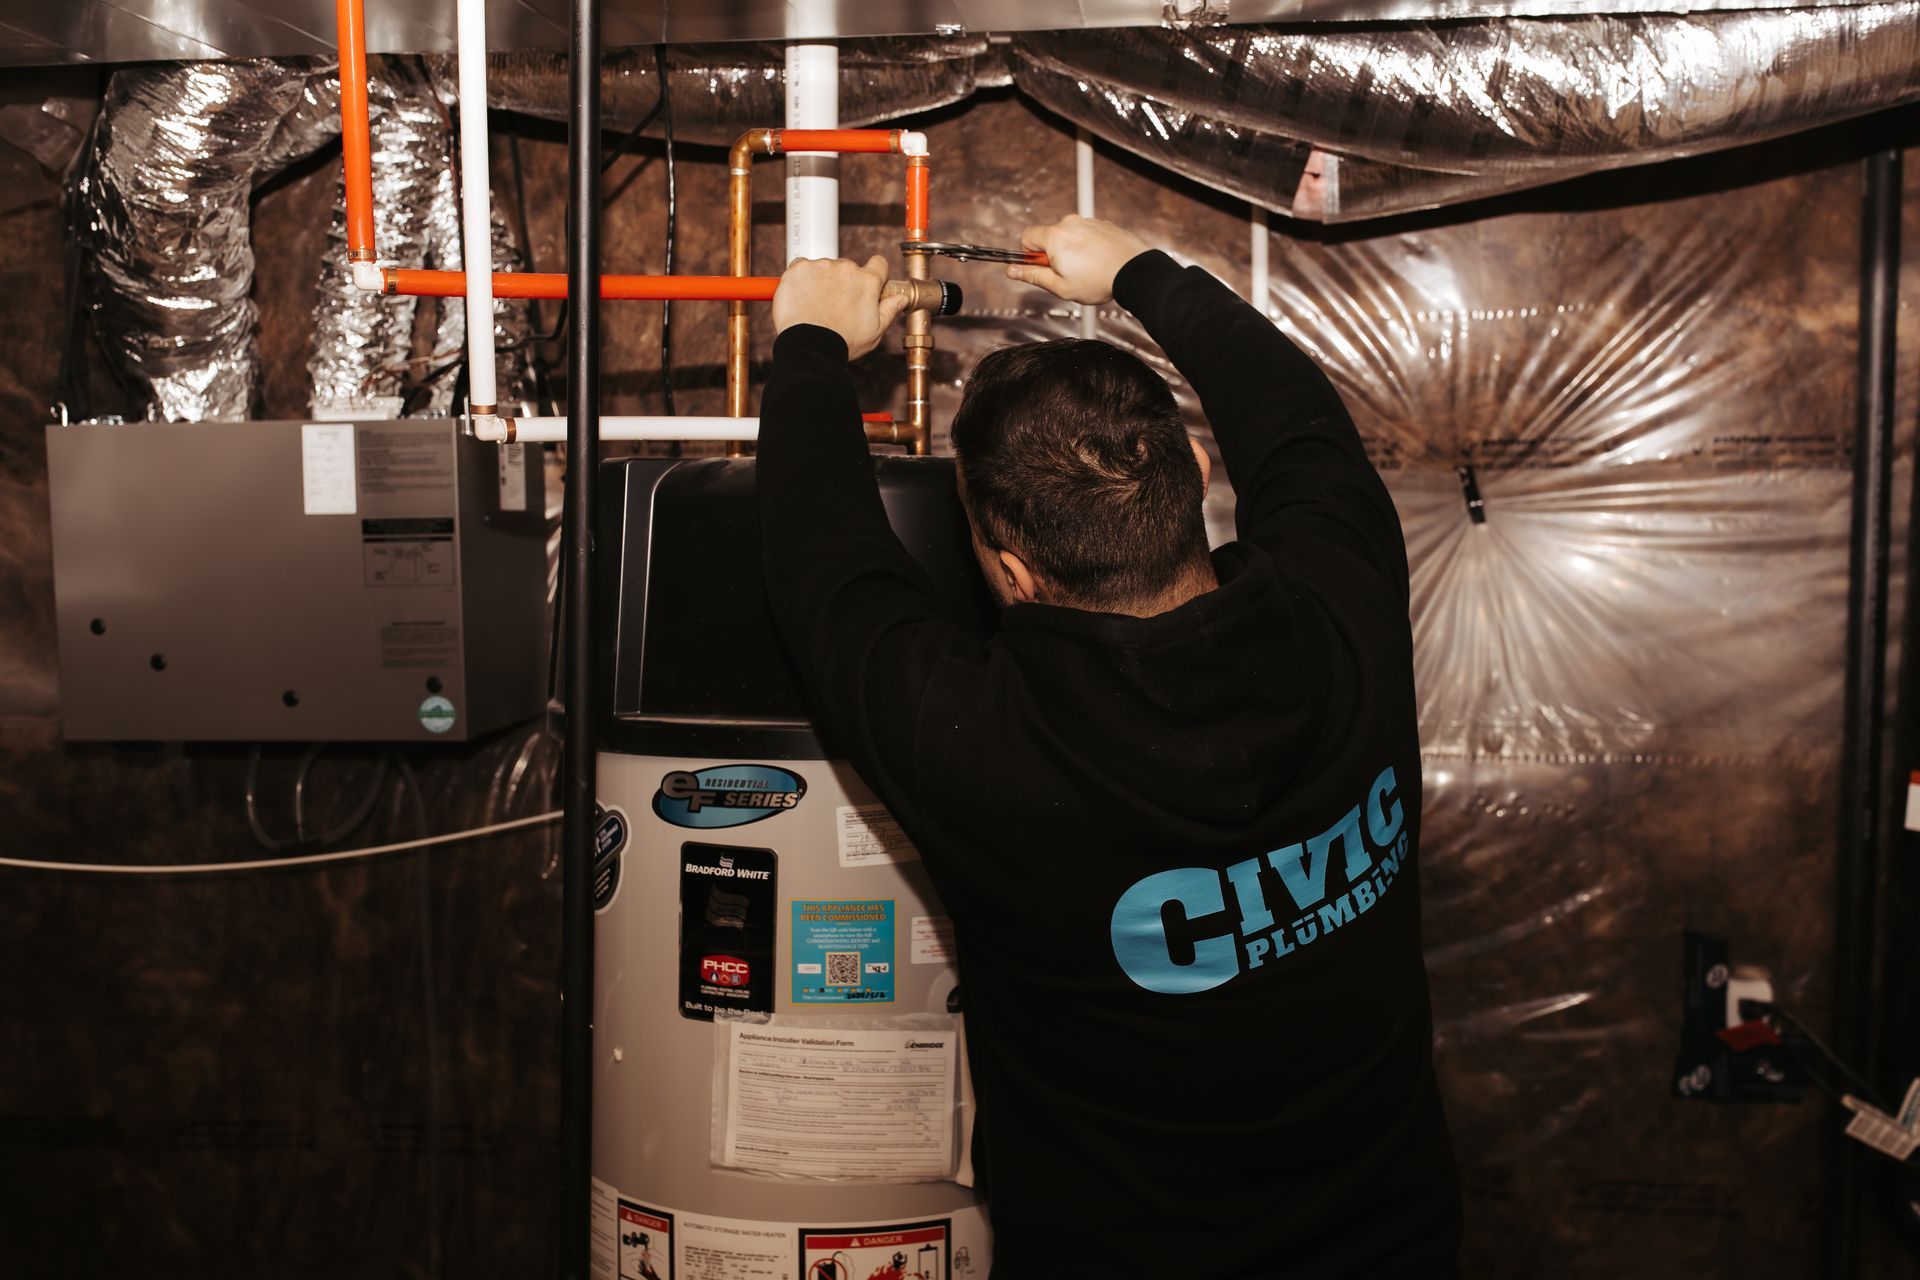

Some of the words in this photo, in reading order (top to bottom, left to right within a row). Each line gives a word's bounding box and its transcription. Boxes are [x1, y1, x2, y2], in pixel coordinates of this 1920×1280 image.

[704, 777, 770, 789] RESIDENTIAL
[723, 791, 800, 809] SERIES
[685, 863, 735, 878] BRADFORD
[736, 868, 770, 880] WHITE
[1111, 766, 1404, 994] CIVIC
[803, 904, 820, 912] THIS
[822, 904, 866, 912] APPLIANCE
[703, 959, 748, 974] PHCC
[685, 1000, 702, 1010] Built
[704, 1004, 713, 1012] to
[714, 1006, 726, 1014] be
[739, 1032, 772, 1041] Appliance
[773, 1036, 800, 1044] Installer
[863, 1235, 903, 1246] DANGER
